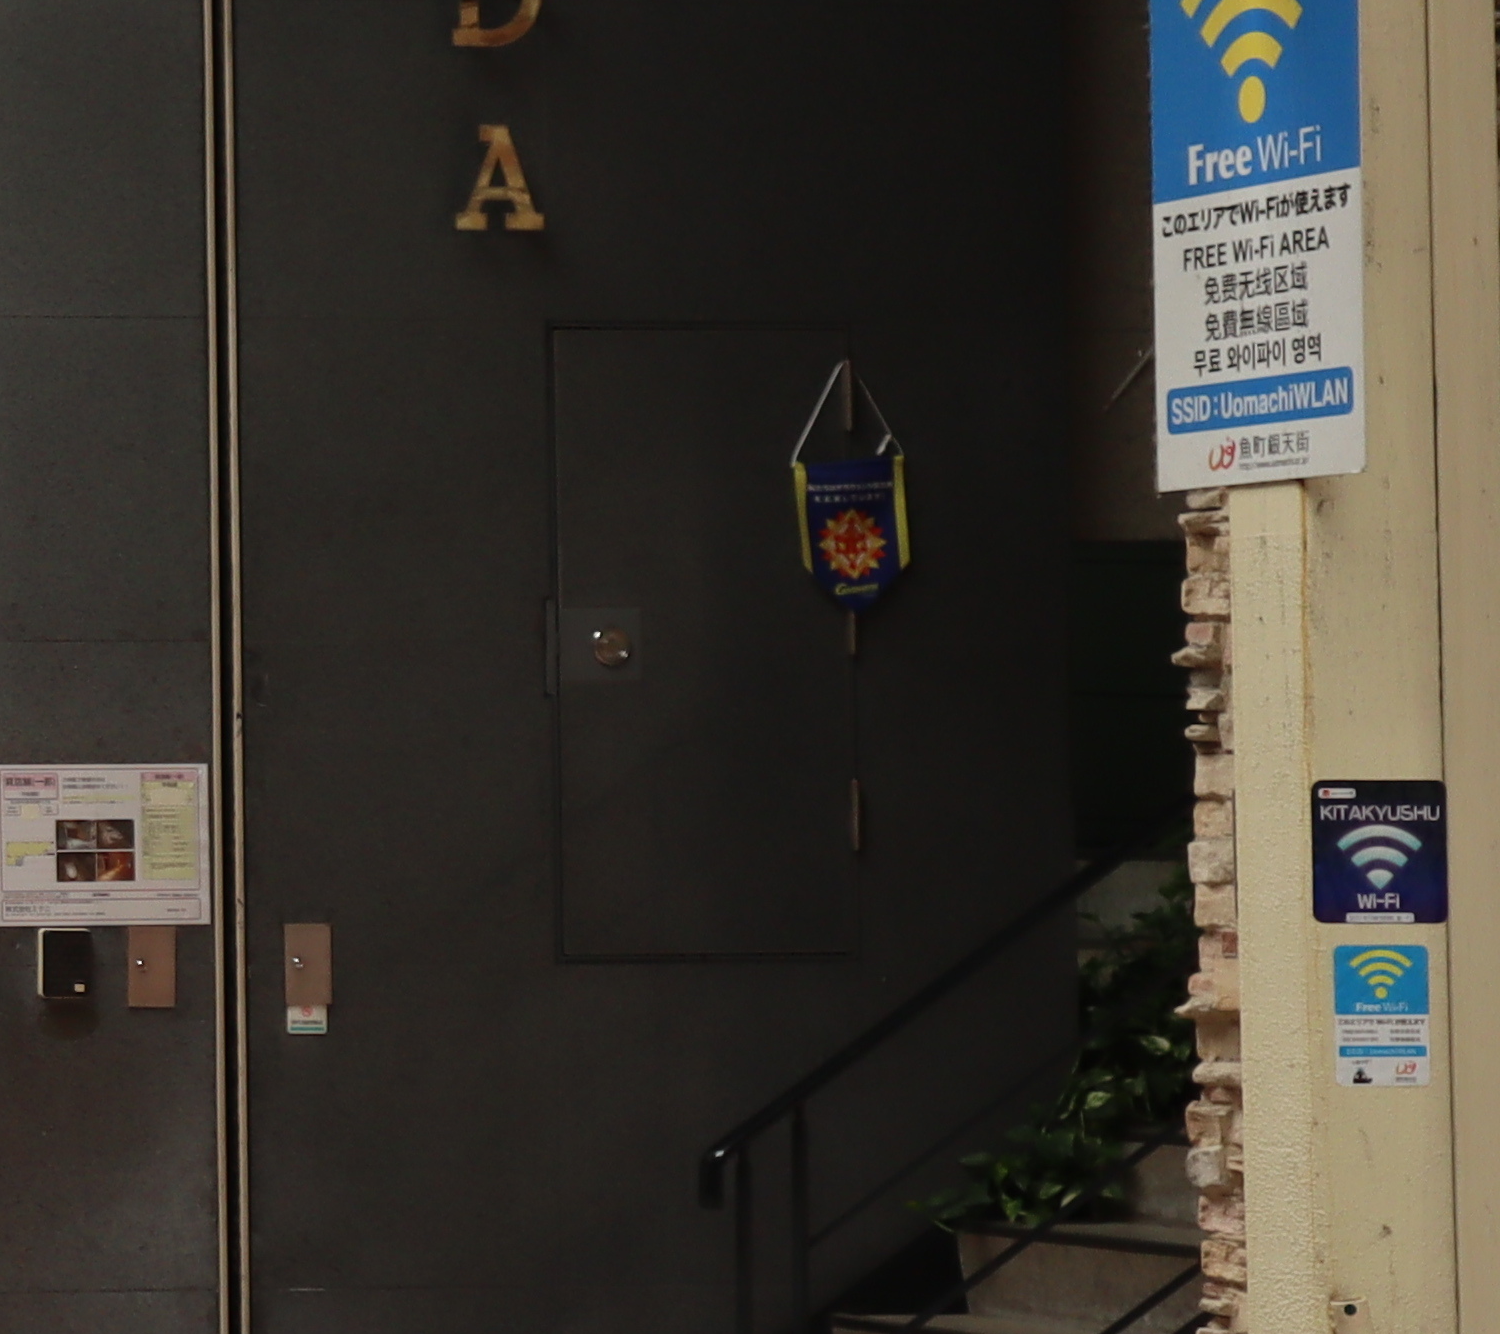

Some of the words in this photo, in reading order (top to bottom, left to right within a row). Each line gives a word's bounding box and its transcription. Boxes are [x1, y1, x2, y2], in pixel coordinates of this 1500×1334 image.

[1187, 143, 1253, 187] Free
[1257, 124, 1322, 173] Wi-Fi
[1161, 183, 1352, 239] このエリアでWi-Fiが使えます
[1182, 241, 1228, 273] FREE
[1231, 234, 1276, 264] Wi-Fi
[1279, 225, 1331, 255] AREA
[1319, 804, 1441, 822] KITAKYUSHU
[1356, 892, 1401, 911] Wi-Fi
